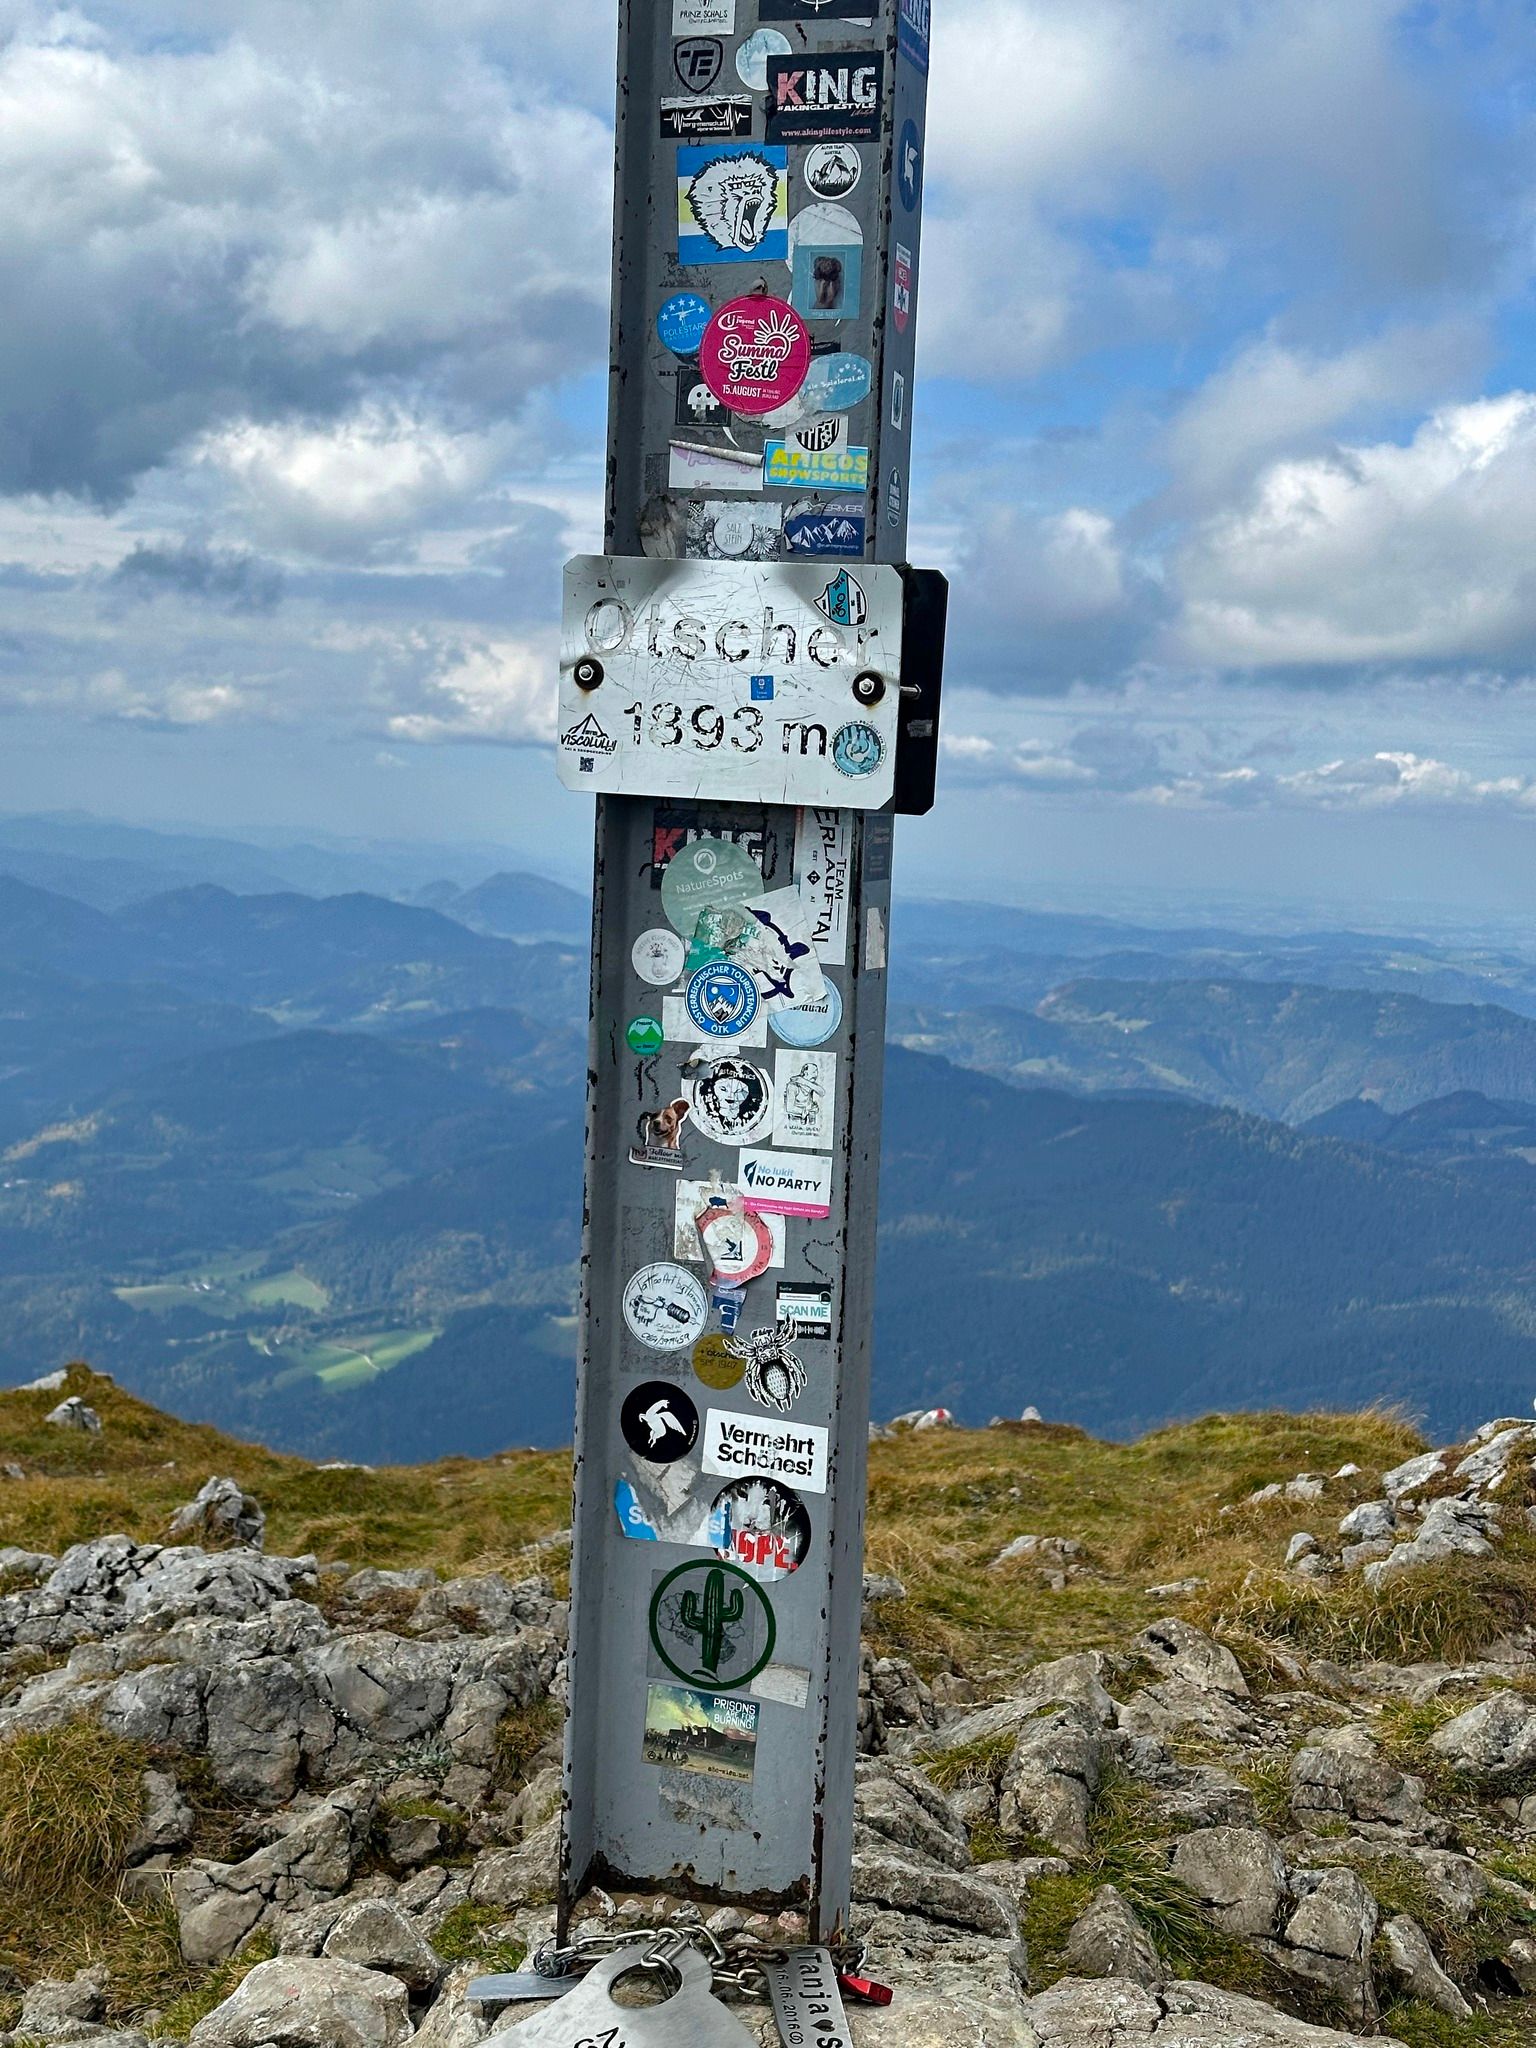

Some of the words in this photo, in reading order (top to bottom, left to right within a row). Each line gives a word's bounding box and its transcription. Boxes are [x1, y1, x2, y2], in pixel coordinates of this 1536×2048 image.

[777, 66, 877, 105] KING
[776, 102, 877, 112] #AKINGLIFESTYLE
[781, 127, 872, 138] www.akinglifestyle.com
[718, 334, 789, 363] Summa
[728, 359, 778, 382] Festl
[771, 447, 868, 472] AMIGOS
[726, 522, 743, 533] SALZ
[724, 534, 744, 545] STEIN
[623, 700, 764, 753] 1893
[781, 720, 828, 757] m
[675, 871, 745, 894] NatureSpots
[834, 858, 848, 900] TEAM
[689, 965, 730, 1024] ÖSTERREICHISCHER
[730, 967, 755, 1028] TOURISTENKLUB
[710, 1022, 730, 1034] ÖTK
[758, 1165, 771, 1174] No
[755, 1175, 776, 1187] NO
[777, 1177, 822, 1192] PARTY
[779, 1304, 809, 1316] SCAN
[810, 1306, 829, 1318] ME
[720, 1421, 815, 1456] Vermehrt
[717, 1443, 814, 1477] Schönes!
[713, 1697, 756, 1715] PRISONS
[726, 1709, 739, 1718] ARE
[741, 1712, 756, 1721] FOR
[713, 1713, 755, 1730] BURNING!
[796, 1952, 833, 2015] Tanja
[775, 1968, 801, 2030] 16.06.2016
